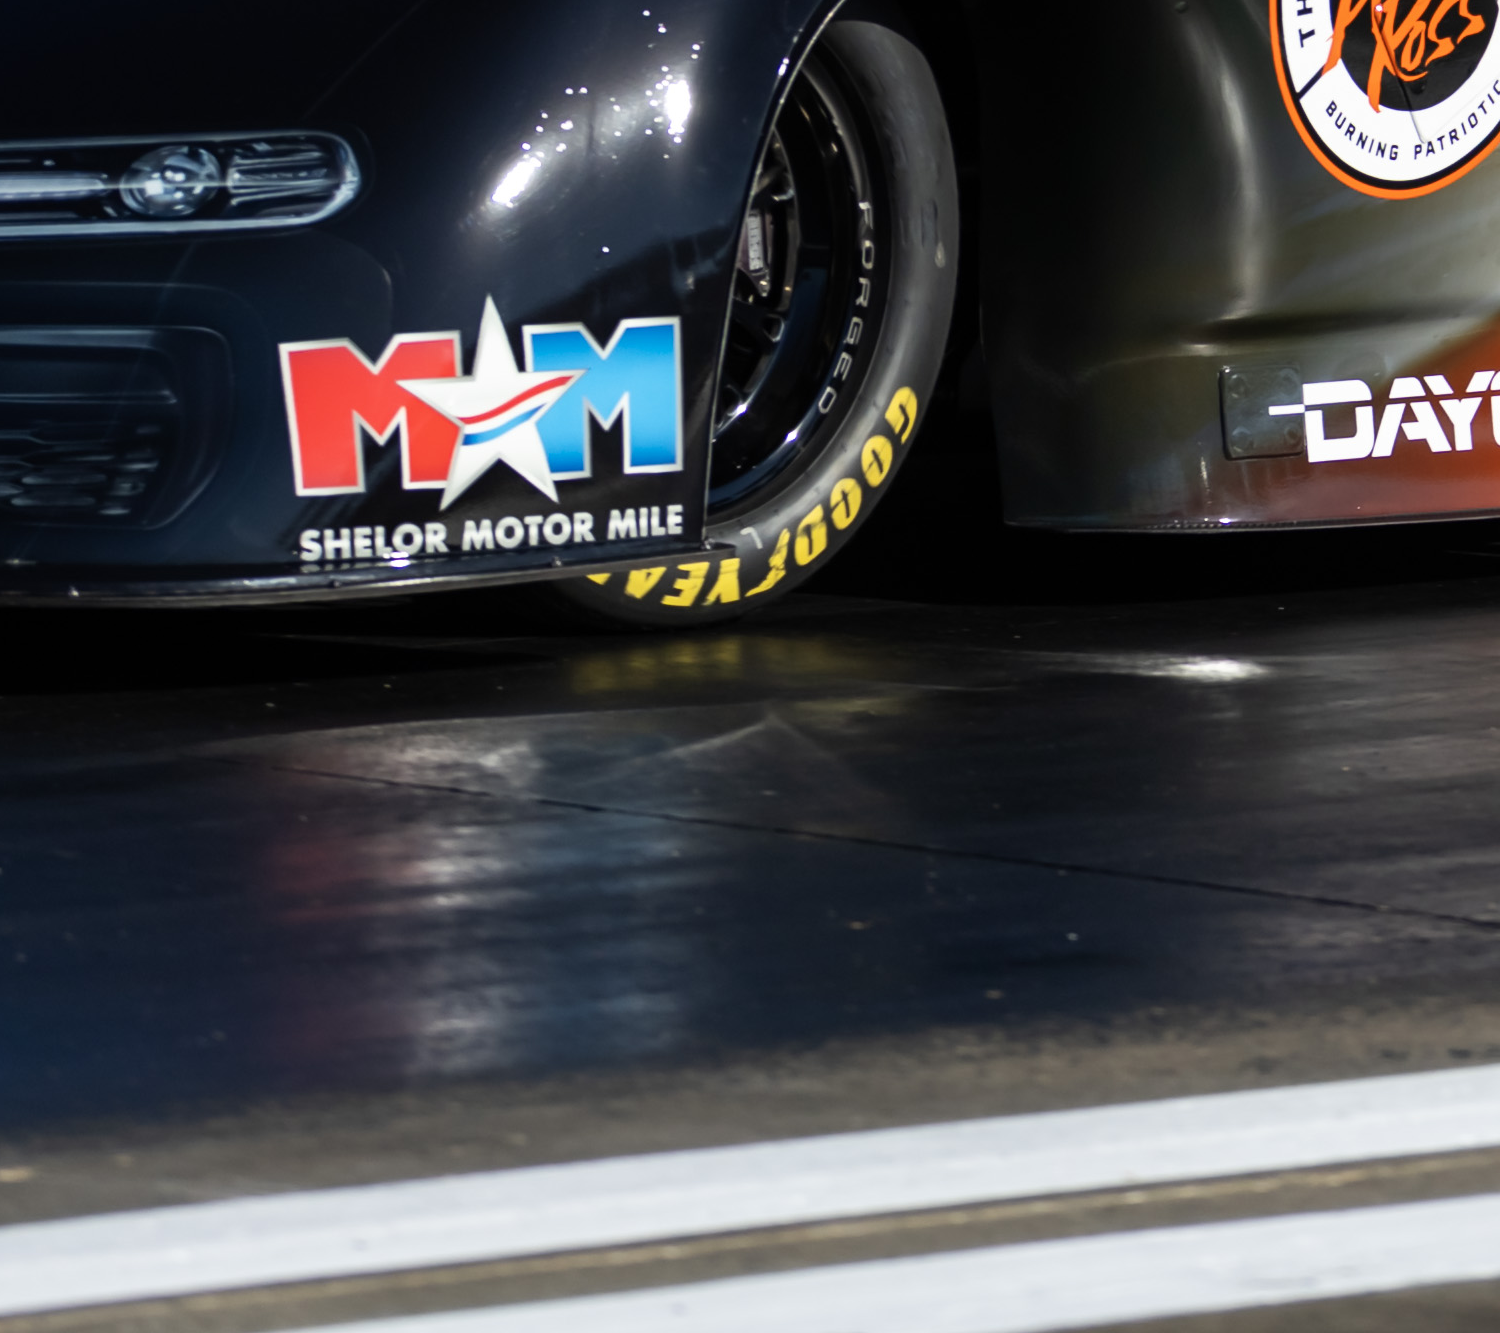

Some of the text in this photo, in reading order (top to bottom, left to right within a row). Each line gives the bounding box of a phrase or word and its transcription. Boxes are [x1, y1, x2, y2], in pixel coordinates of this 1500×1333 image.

[1325, 100, 1400, 161] BURNING
[817, 199, 875, 416] FORGED
[300, 503, 685, 562] SHELOR MOTOR MILE
[586, 385, 919, 609] GOODYEA
